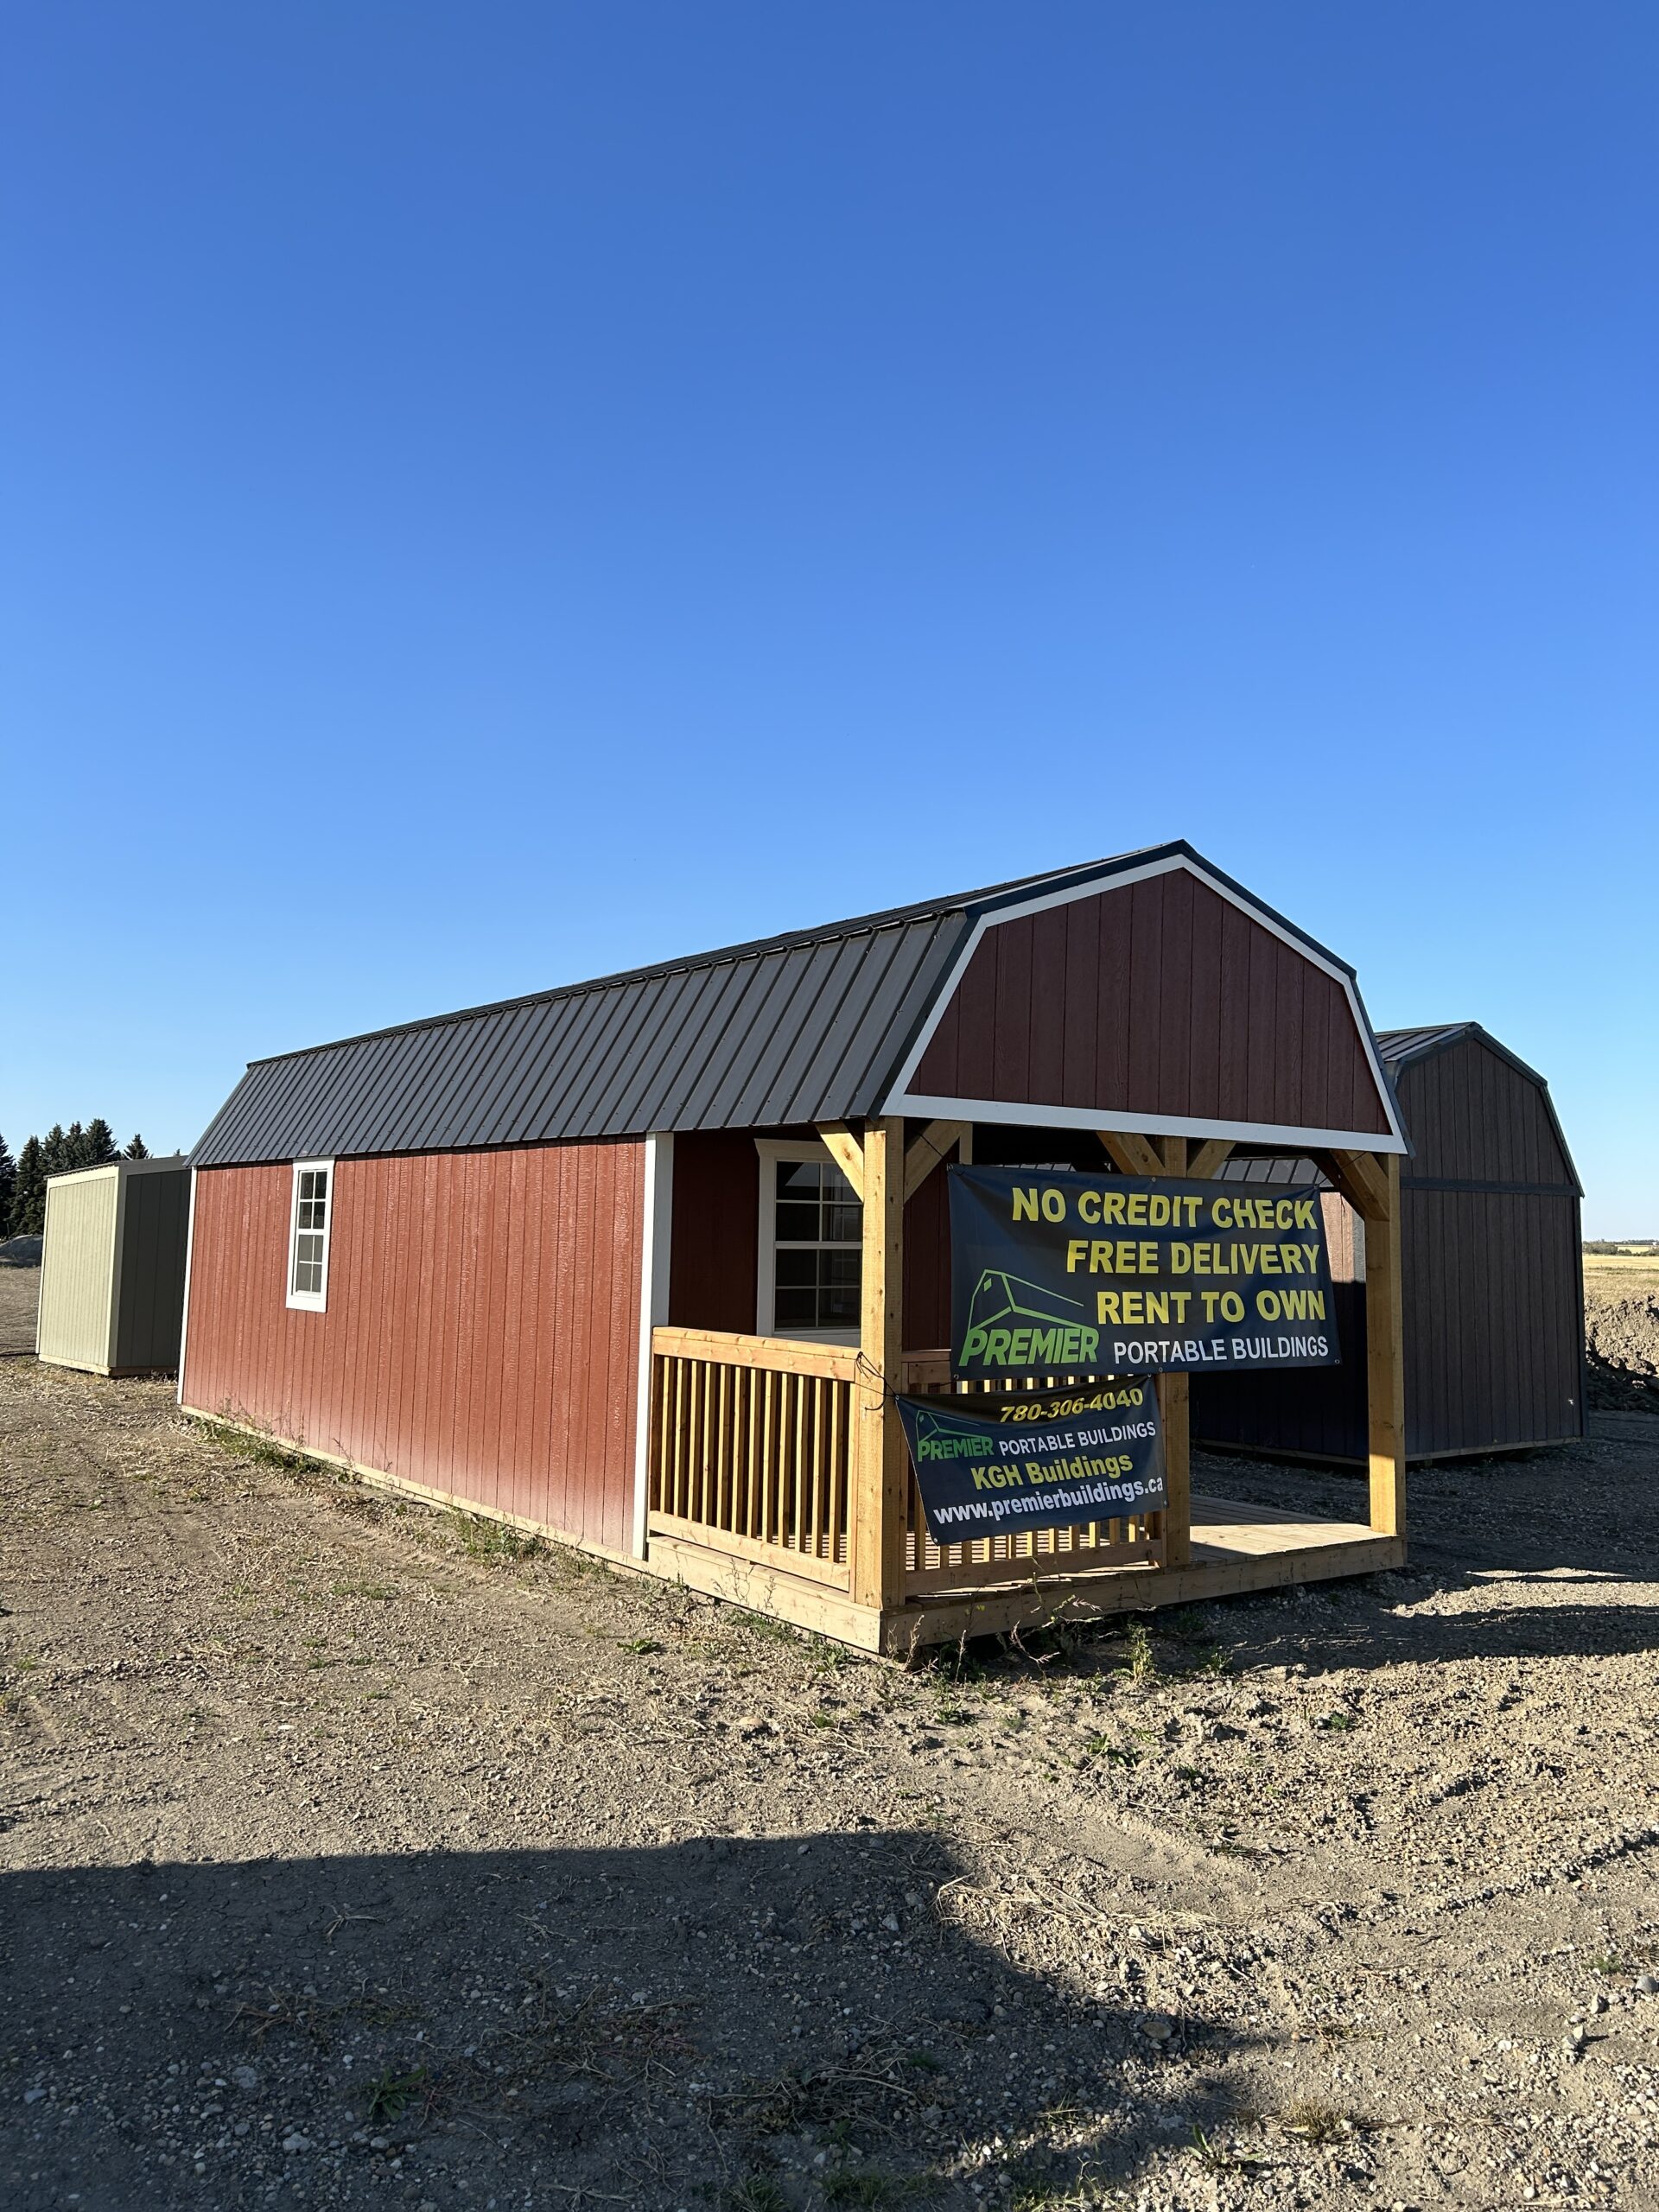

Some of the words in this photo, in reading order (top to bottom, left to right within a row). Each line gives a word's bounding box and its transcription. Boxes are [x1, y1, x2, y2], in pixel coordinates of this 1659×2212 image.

[1012, 1187, 1066, 1223] NO
[1077, 1191, 1203, 1228] CREDIT
[1211, 1198, 1318, 1230] CHECK
[1066, 1239, 1160, 1274] FREE
[1171, 1242, 1319, 1274] DELIVERY
[1096, 1291, 1192, 1325] RENT
[1201, 1289, 1245, 1324] TO
[1256, 1290, 1326, 1322] OWN
[958, 1327, 1100, 1366] PREMIER
[1114, 1338, 1228, 1364] PORTABLE
[1232, 1336, 1328, 1361] BUILDINGS
[1000, 1388, 1143, 1423] 780-306-4040
[917, 1436, 994, 1462] PREMIER
[999, 1433, 1076, 1457] PORTABLE
[1077, 1421, 1156, 1446] BUILDINGS
[970, 1463, 1023, 1491] KGH
[1025, 1454, 1133, 1485] Buildings
[933, 1477, 1164, 1524] www.premierbuildings.ca
